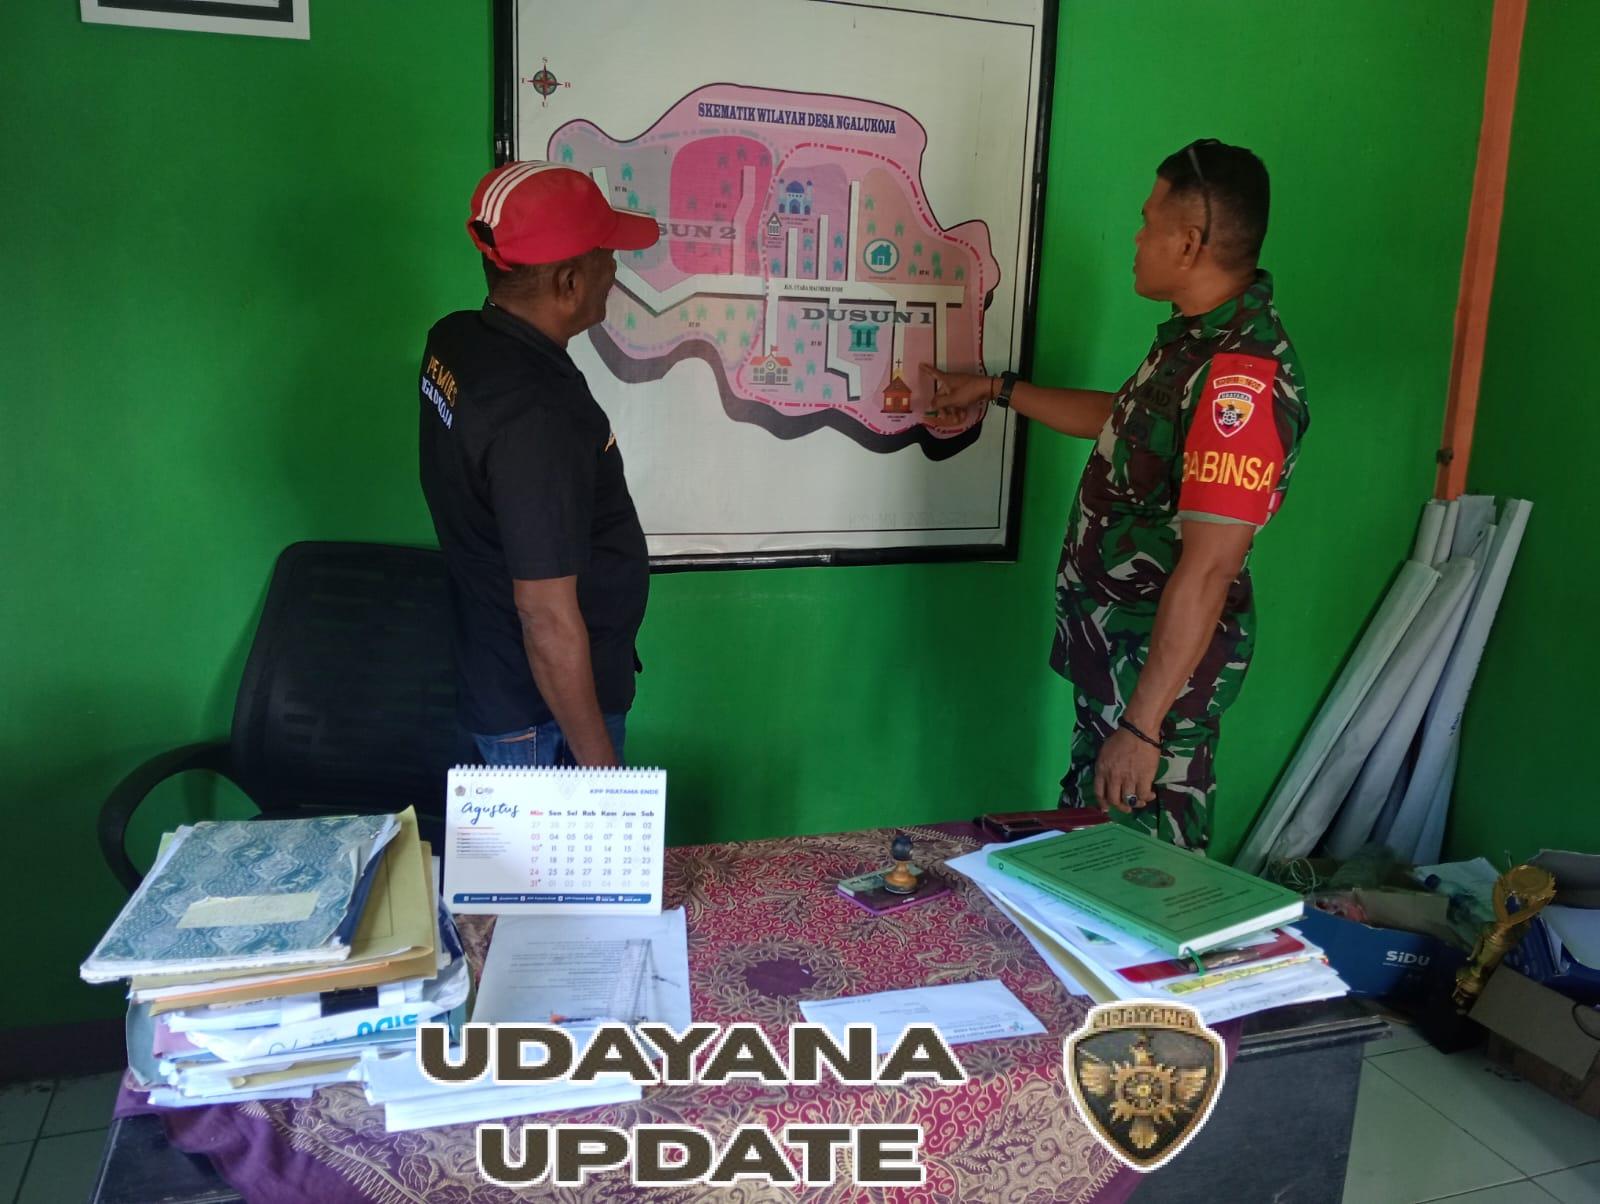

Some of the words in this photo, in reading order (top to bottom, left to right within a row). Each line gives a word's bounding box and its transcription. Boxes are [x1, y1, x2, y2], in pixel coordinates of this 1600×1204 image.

[698, 102, 756, 121] SKEMATIK
[757, 107, 806, 126] WILAYAH
[807, 112, 835, 129] DESA
[835, 114, 897, 134] NGALUKOJA
[657, 222, 713, 239] SUN
[719, 225, 737, 240] 2
[801, 307, 914, 324] DUSUN
[920, 311, 932, 325] 1
[461, 801, 520, 826] Agustus
[549, 833, 559, 841] 04
[566, 833, 576, 841] 05
[583, 833, 593, 841] 06
[603, 833, 613, 841] 07
[623, 834, 633, 842] 08
[642, 834, 651, 842] 09
[549, 856, 557, 864] 18
[566, 856, 574, 864] 19
[583, 856, 592, 864] 20
[604, 856, 612, 864] 21
[622, 857, 632, 865] 22
[641, 857, 651, 865] 23
[529, 868, 539, 876] 24
[548, 868, 558, 876] 25
[565, 868, 575, 876] 26
[582, 868, 592, 876] 27
[602, 868, 612, 876] 28
[622, 869, 631, 877] 29
[641, 869, 650, 877] 30
[1385, 950, 1431, 967] SiDU
